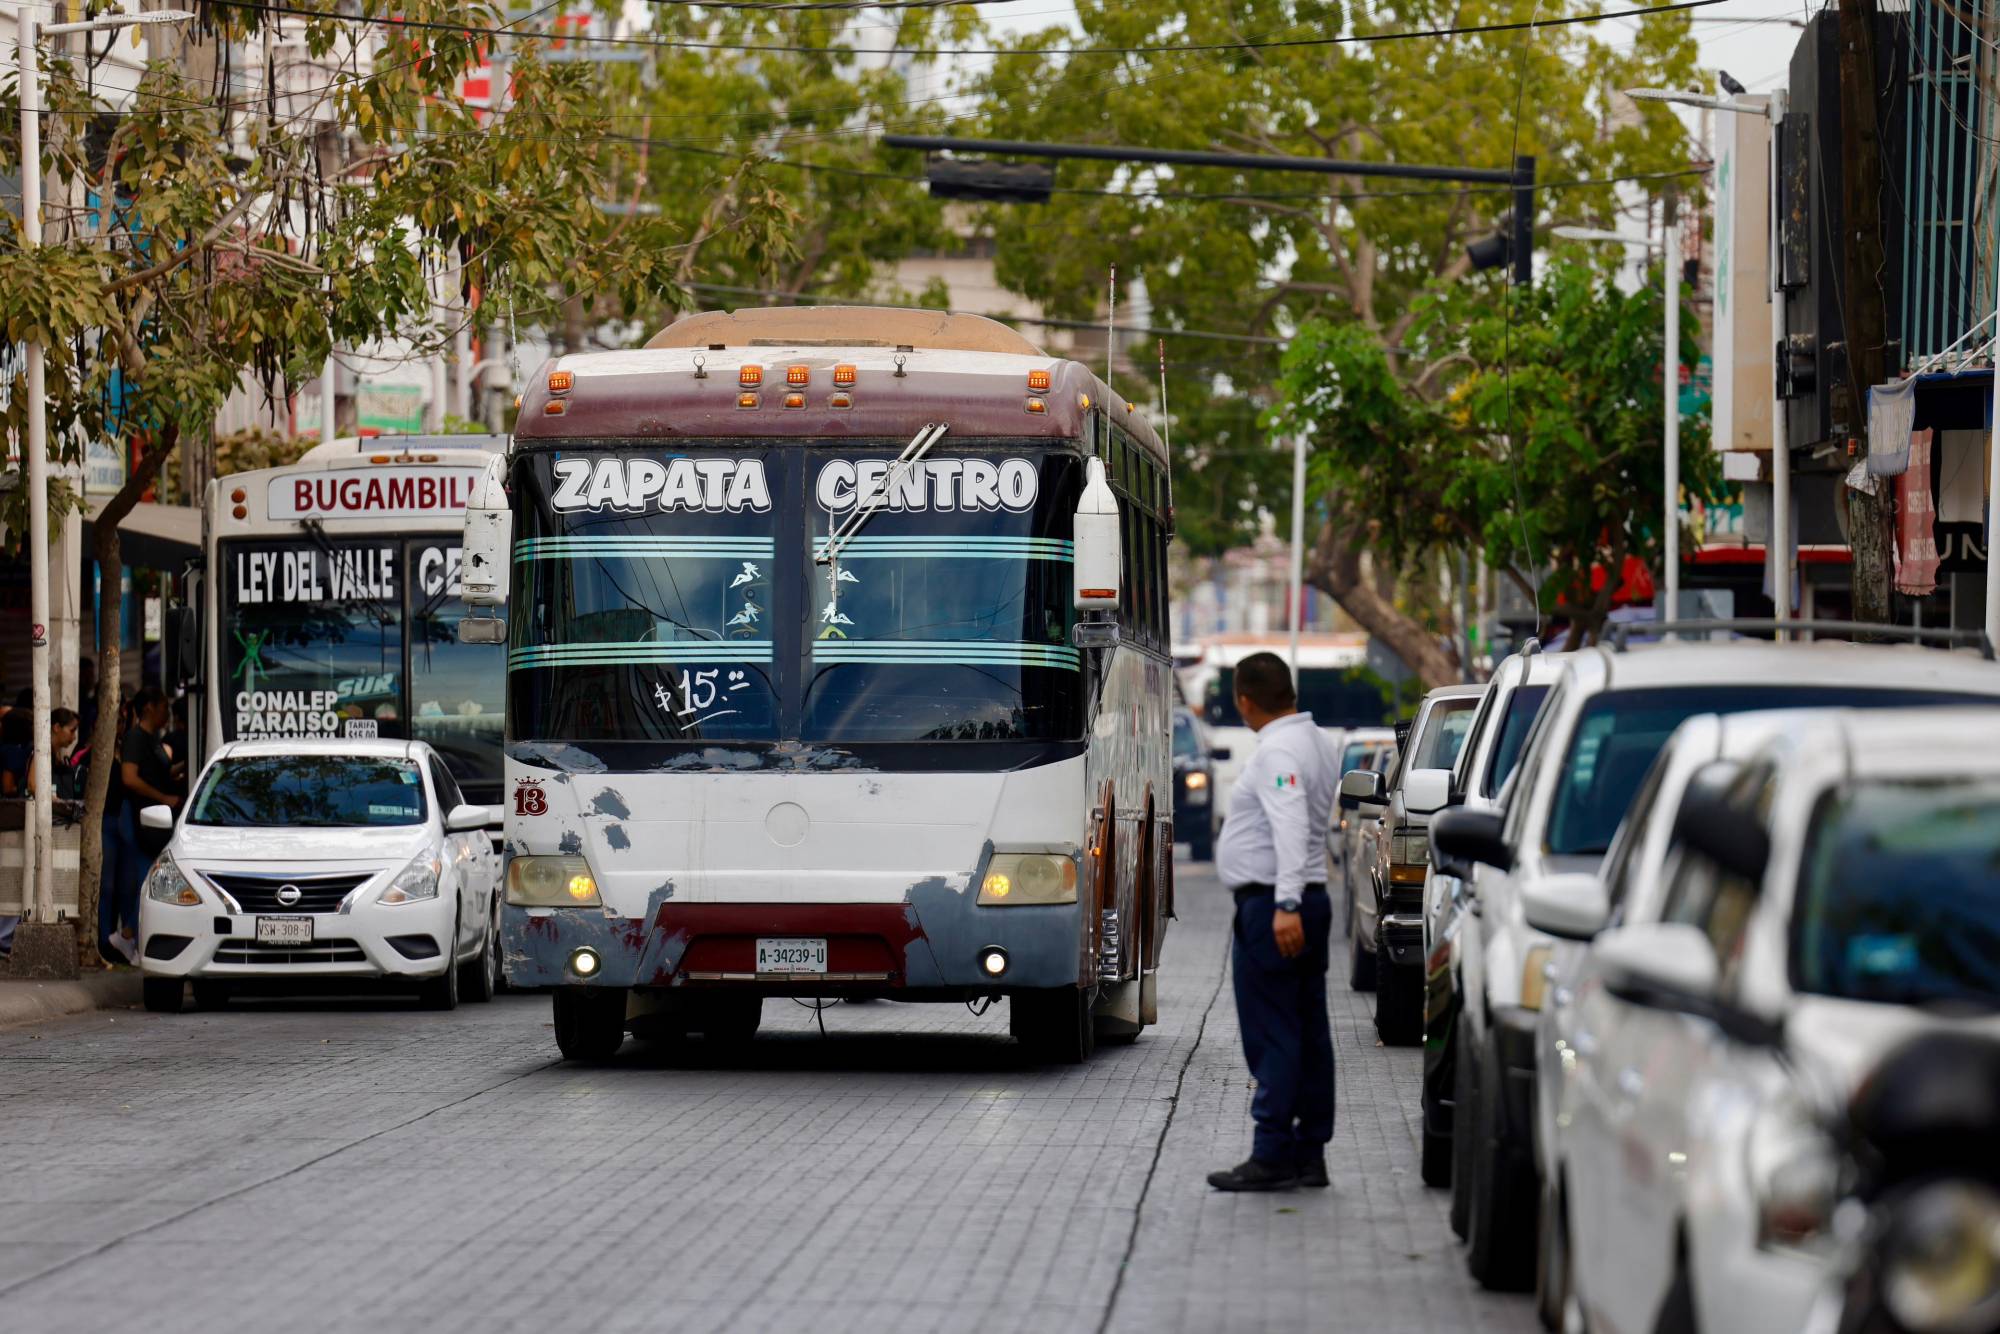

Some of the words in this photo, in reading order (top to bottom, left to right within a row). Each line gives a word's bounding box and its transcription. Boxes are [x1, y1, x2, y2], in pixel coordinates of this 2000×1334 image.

[552, 458, 772, 513] ZAPATA
[816, 458, 1039, 514] CENTRO
[238, 553, 277, 604] LEY
[283, 551, 323, 602] DEL
[327, 548, 394, 600] VALLE
[419, 547, 462, 596] CE
[337, 672, 397, 699] SUR
[236, 690, 338, 712] CONALEP
[236, 710, 339, 732] PARAISO
[348, 720, 376, 729] TARIFA
[513, 786, 549, 816] 13
[759, 948, 824, 963] A-34239-U
